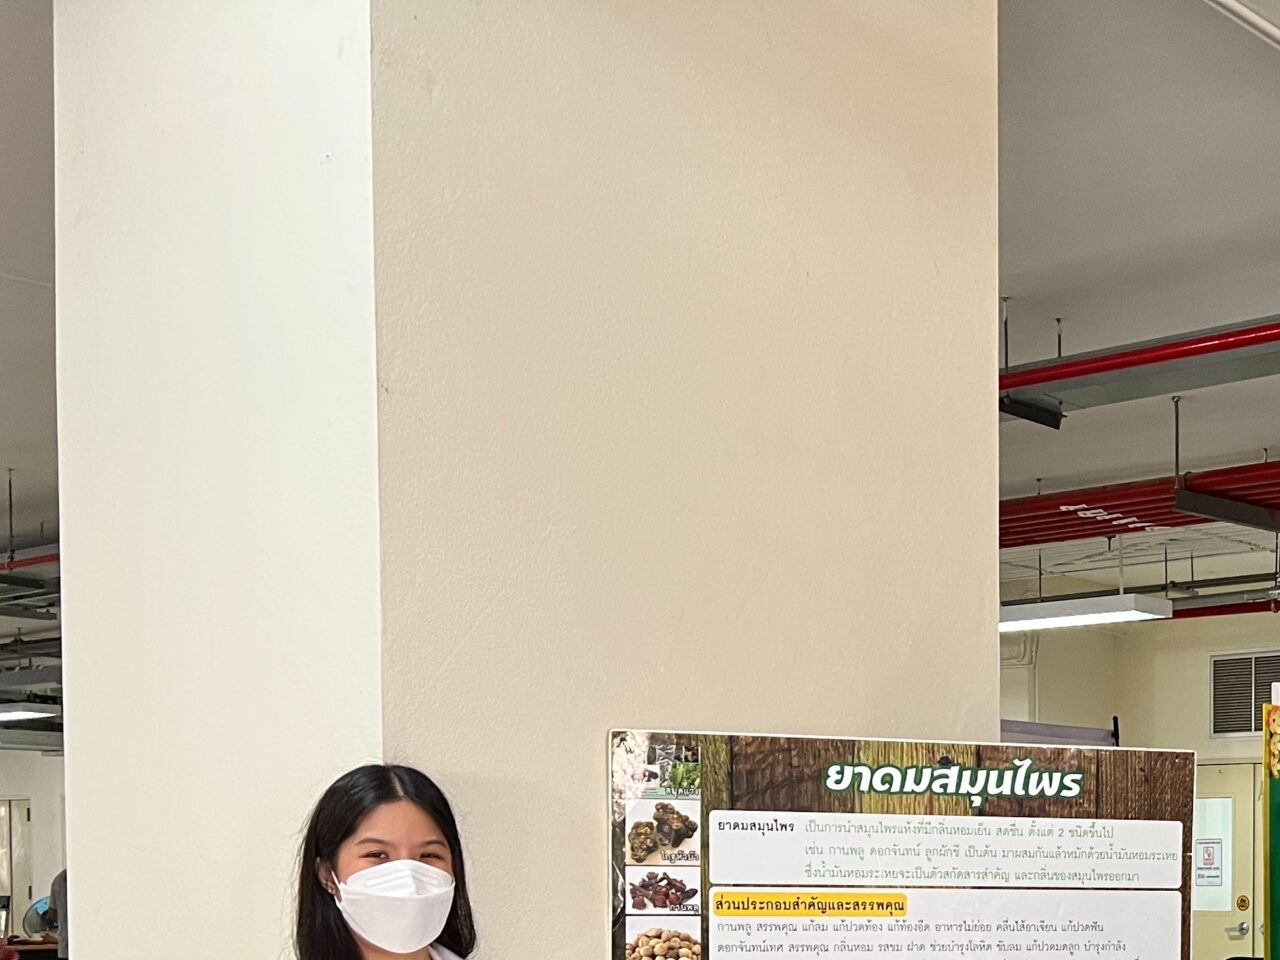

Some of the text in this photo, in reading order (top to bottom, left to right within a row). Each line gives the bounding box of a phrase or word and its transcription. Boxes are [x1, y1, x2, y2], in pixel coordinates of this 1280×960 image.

[825, 758, 1083, 807] ยาดมสมุนไพร
[718, 819, 795, 836] ยาดมสมุนไพร
[1058, 828, 1064, 837] 2
[805, 842, 823, 855] เช่น
[829, 845, 864, 860] กานพลู
[870, 843, 920, 856] ดอกจันทน์
[965, 846, 997, 858] เป็นต้น
[715, 895, 904, 915] ส่วนประกอบสำคัญและสรรพคุณ
[717, 922, 751, 935] กานพลู
[756, 923, 797, 935] สรรพคุณ
[802, 920, 828, 932] แก้ลม
[833, 919, 882, 932] แก้ปวดท้อง
[888, 919, 930, 932] แก้ท้องอืด
[935, 921, 991, 932] อาหารไม่ย่อย
[1062, 921, 1103, 932] แก้ปวดฟัน
[717, 940, 784, 952] ดอกจันทน์เทศ
[789, 943, 828, 956] สรรพคุณ
[833, 936, 873, 952] กลิ่นหอม
[997, 941, 1021, 951] ขับลม
[1026, 940, 1080, 955] แก้ปวดมดลูก
[1084, 940, 1126, 954] บำรุงกำลัง
